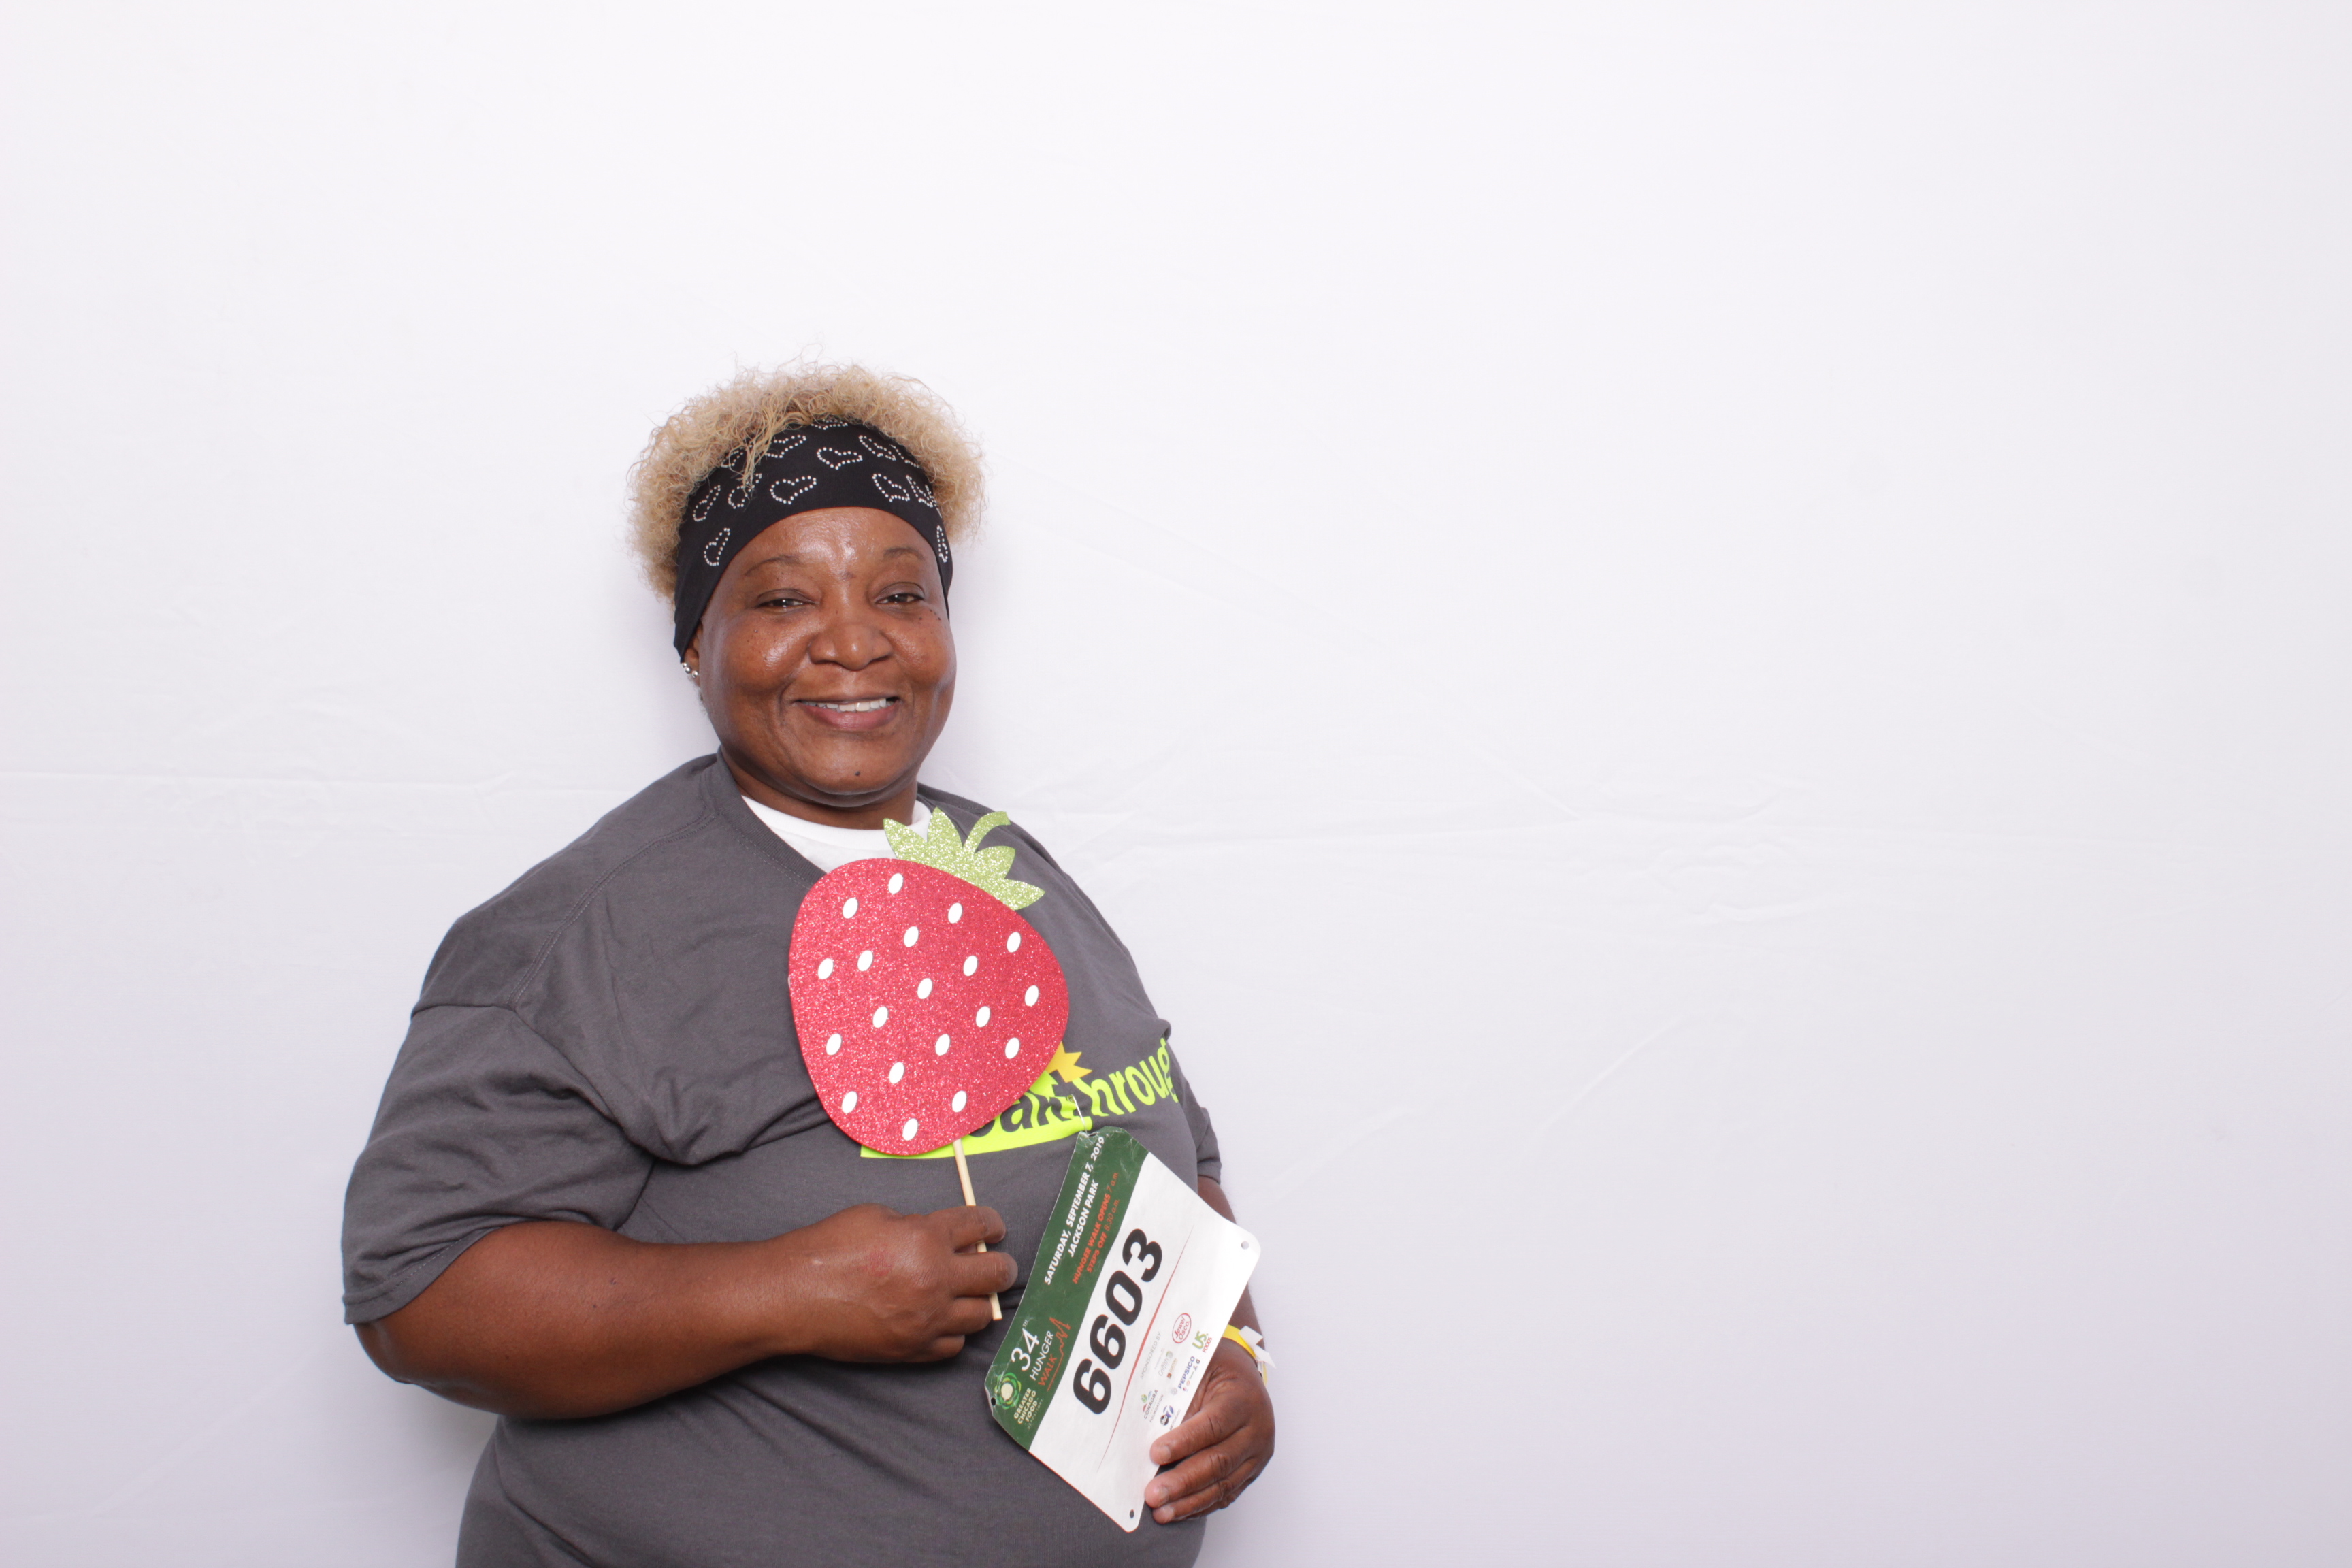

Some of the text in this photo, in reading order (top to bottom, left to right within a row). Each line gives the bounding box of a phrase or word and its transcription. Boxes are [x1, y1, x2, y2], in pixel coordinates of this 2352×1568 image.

[1045, 1136, 1105, 1285] SATURDAY, SEPTEMBER 7, 2019
[1068, 1179, 1099, 1258] JACKSON PARK
[1073, 1247, 1090, 1284] HUNGER
[1088, 1221, 1102, 1247] WALK
[1098, 1193, 1111, 1222] OPENS
[1111, 1172, 1120, 1186] a.m.
[1087, 1199, 1120, 1273] STEPS OFF 8:30 a.m.
[1073, 1228, 1162, 1414] 6603
[1174, 1316, 1186, 1338] Jewel
[1030, 1330, 1054, 1381] HUNGER
[1140, 1341, 1158, 1379] SPONSORED
[1202, 1337, 1212, 1353] FOODS
[1038, 1354, 1058, 1386] WALK
[1158, 1357, 1169, 1377] Griffith
[1178, 1356, 1195, 1390] PEPSICO
[1014, 1388, 1032, 1419] GREATER
[1018, 1390, 1036, 1424] CHICAGO
[1026, 1401, 1038, 1422] FOOD
[1143, 1389, 1158, 1419] CONAGRA
[1149, 1394, 1164, 1423] FOUNDATION
